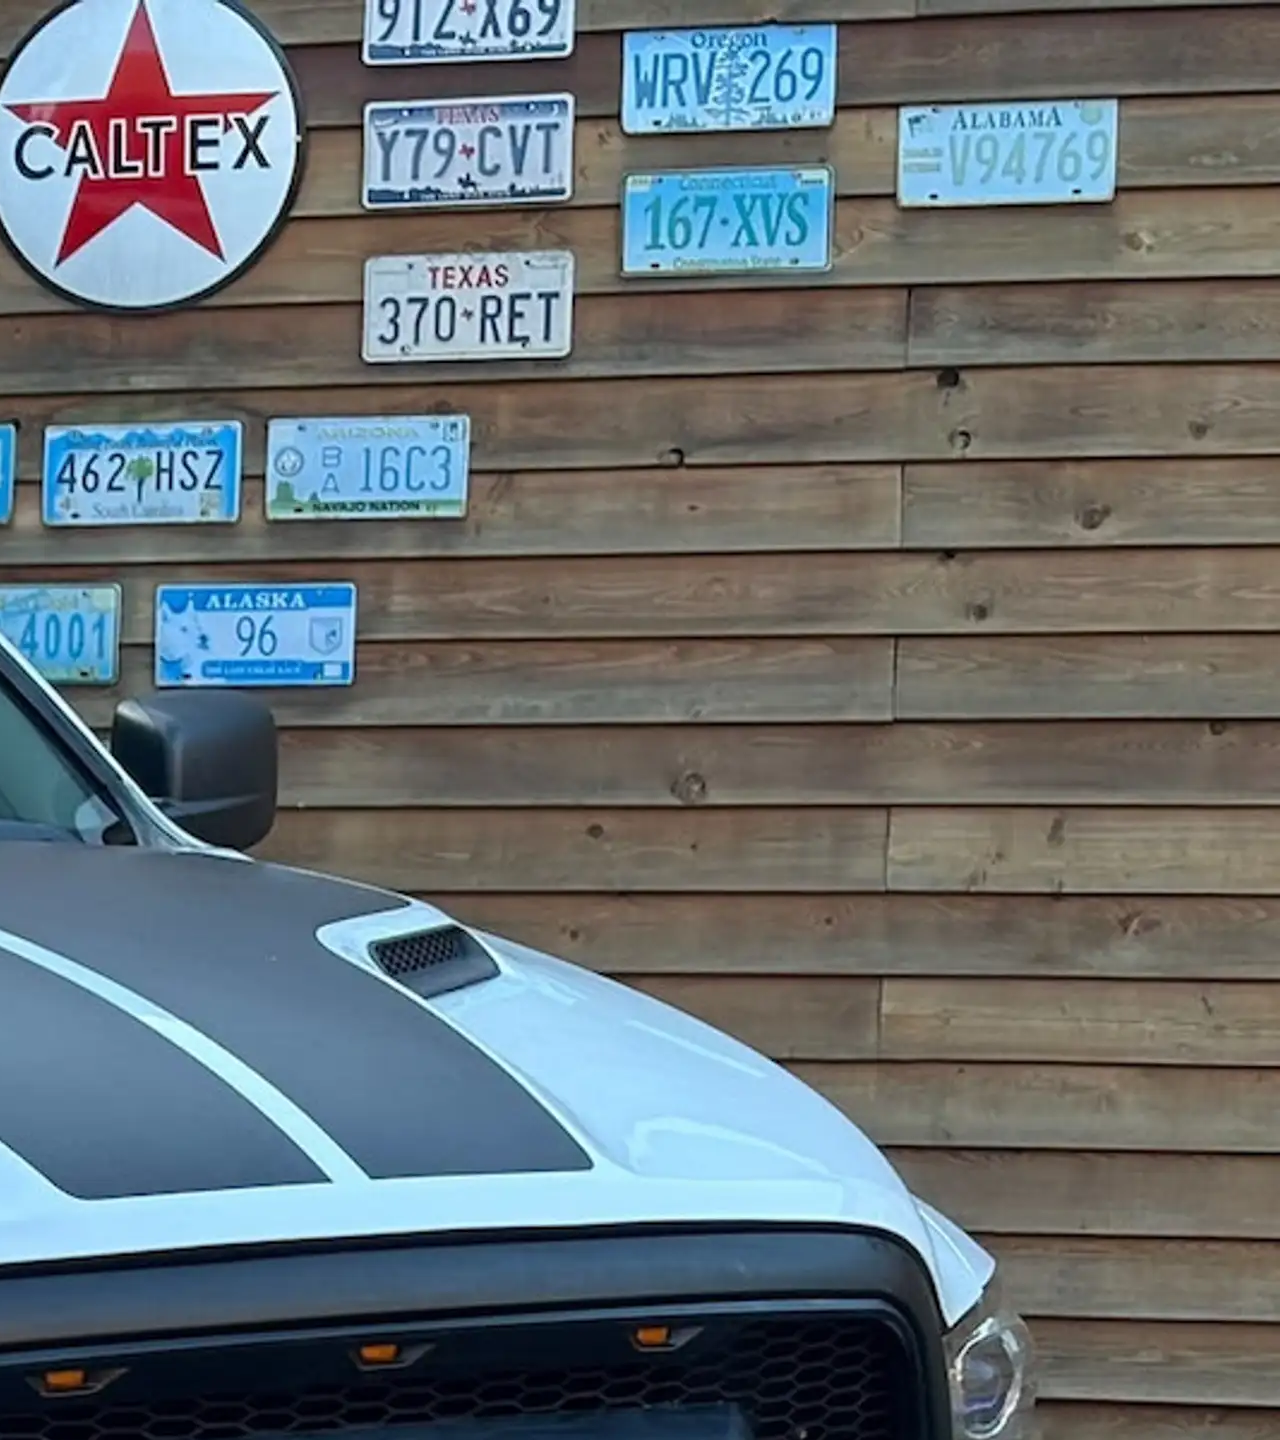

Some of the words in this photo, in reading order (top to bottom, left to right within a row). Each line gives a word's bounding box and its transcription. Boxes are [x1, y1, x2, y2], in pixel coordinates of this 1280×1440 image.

[691, 31, 767, 50] Oregon
[634, 50, 717, 109] WRV
[747, 47, 824, 105] 269
[437, 106, 500, 125] TEXAS
[951, 106, 1062, 130] ALABAMA
[14, 114, 272, 181] CALTEX
[376, 127, 456, 182] Y79
[477, 121, 560, 177] CVT
[948, 130, 1110, 187] V94769
[427, 264, 510, 290] TEXAS
[378, 296, 457, 346] 370
[479, 290, 560, 345] RET
[56, 452, 127, 494] 462
[155, 449, 225, 492] HSZ
[359, 445, 452, 493] 16C3
[312, 500, 366, 513] NAVAJO
[369, 499, 421, 512] NATION
[206, 591, 306, 610] ALASKA
[20, 611, 106, 660] 4001
[235, 614, 278, 657] 96
